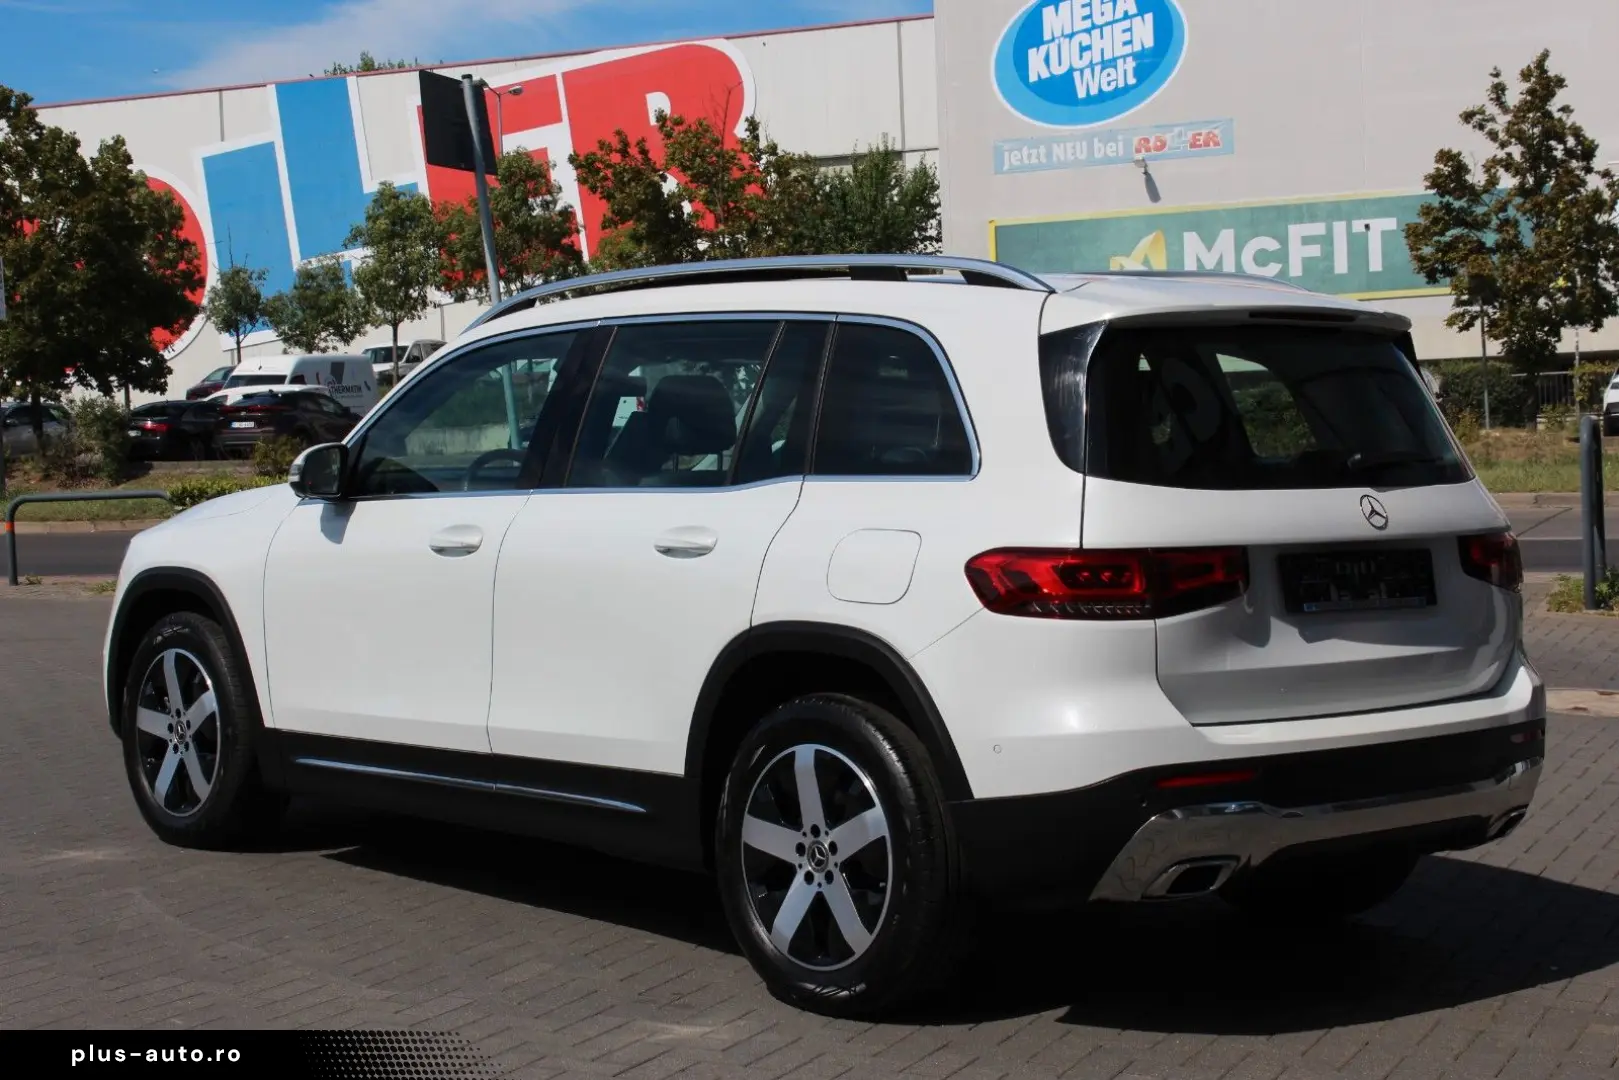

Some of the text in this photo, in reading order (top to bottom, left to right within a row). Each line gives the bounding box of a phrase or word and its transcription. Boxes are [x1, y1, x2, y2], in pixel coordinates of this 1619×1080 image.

[1042, 0, 1138, 41] MEGA
[1027, 12, 1154, 83] KÜCHEN
[1073, 55, 1137, 99] Welt
[1003, 144, 1047, 171] jetzt
[1052, 141, 1088, 164] NEU
[1093, 136, 1124, 159] bei
[1182, 217, 1398, 277] McFIT
